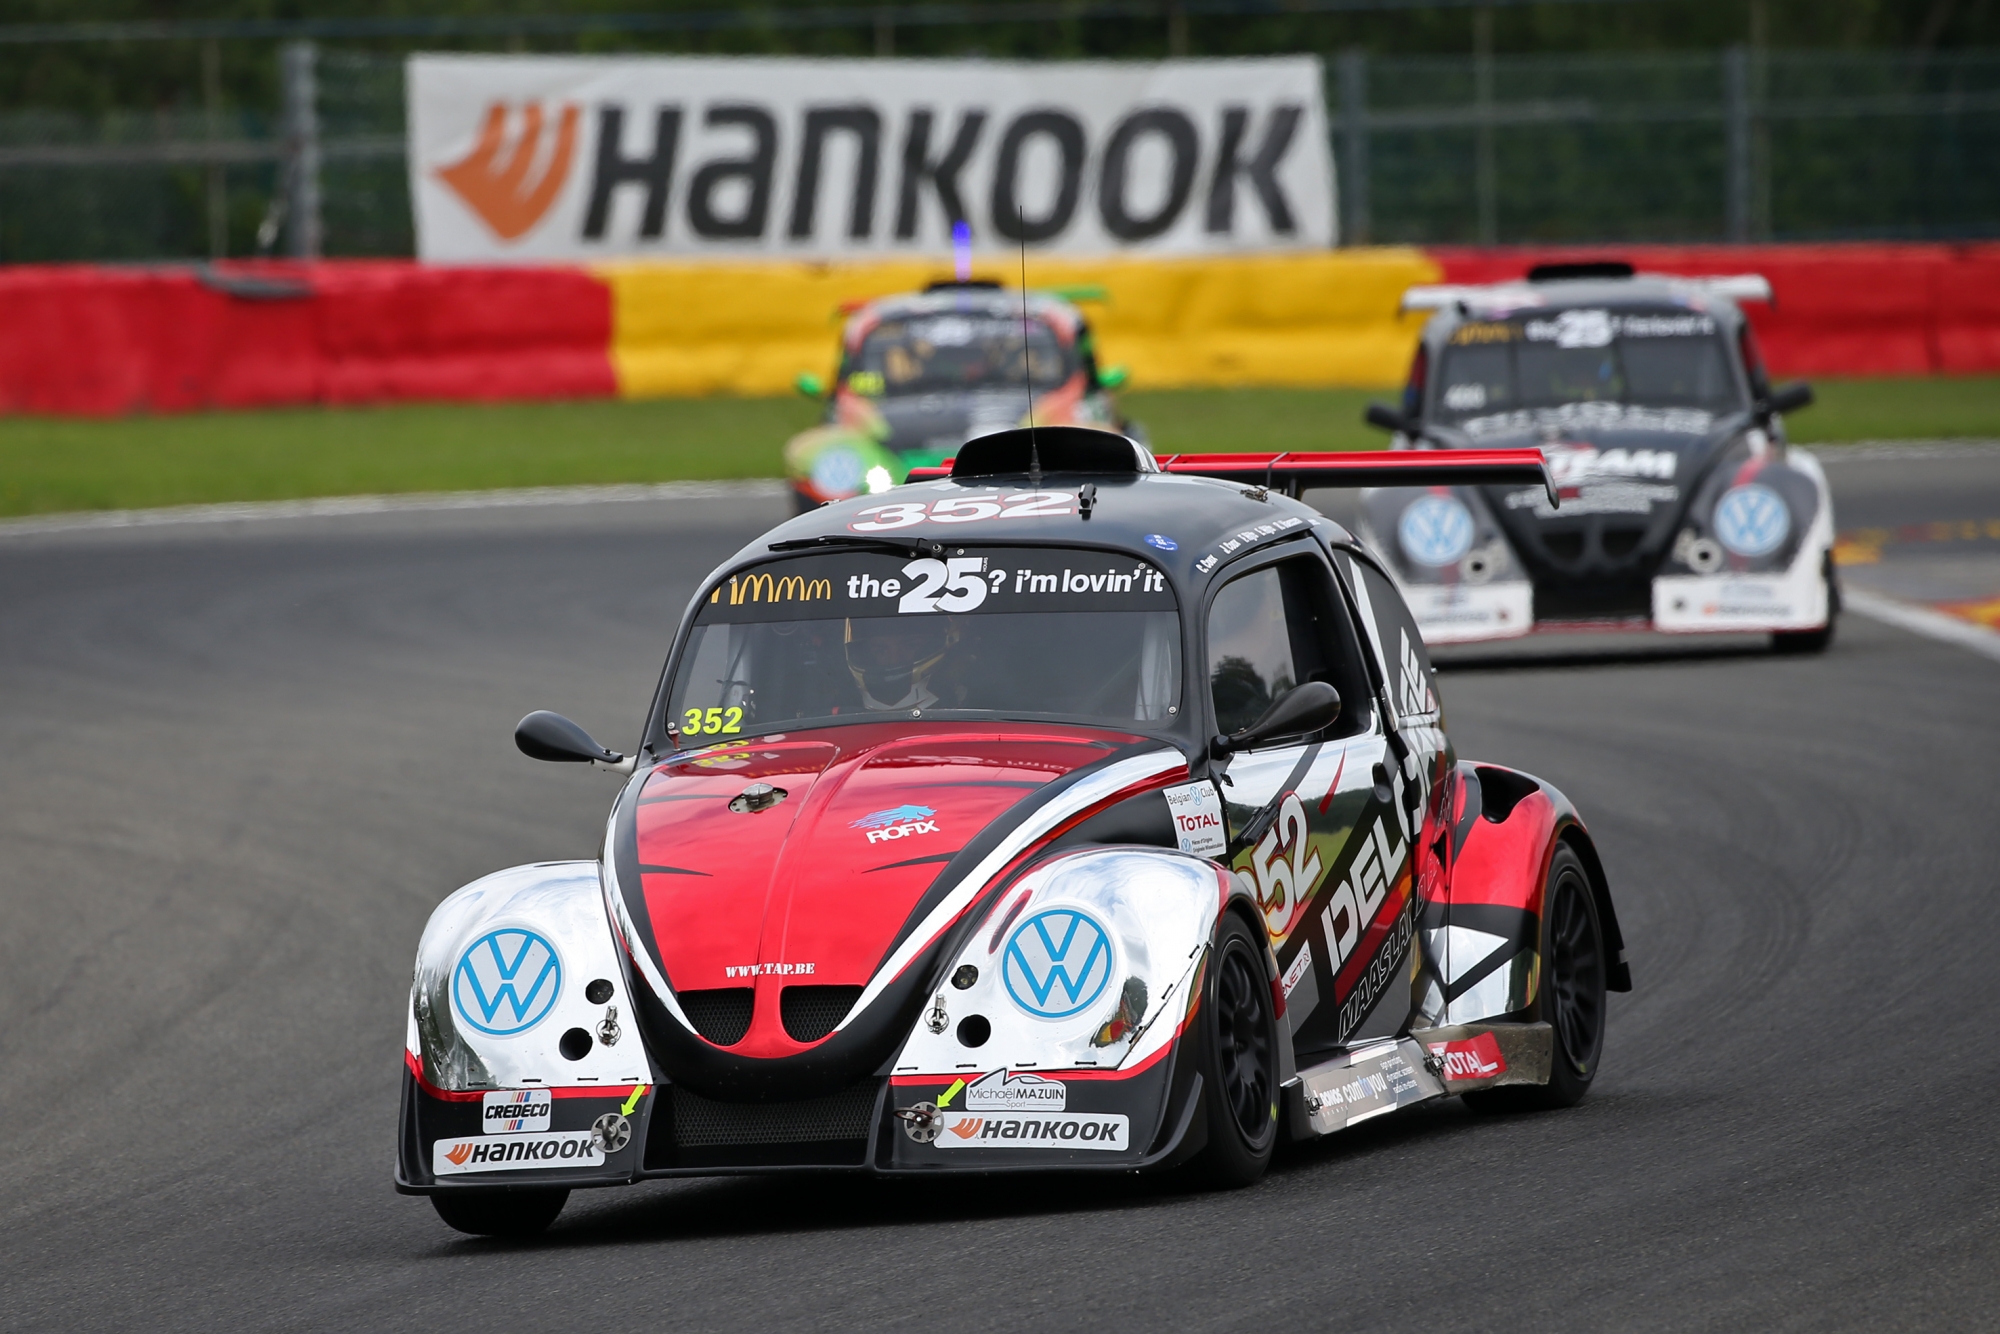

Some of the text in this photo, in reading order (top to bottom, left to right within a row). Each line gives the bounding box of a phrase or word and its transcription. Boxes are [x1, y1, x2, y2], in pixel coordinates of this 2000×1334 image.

[850, 491, 1076, 531] 352
[847, 570, 900, 598] the
[1014, 570, 1058, 593] i'm
[1062, 568, 1139, 593] lovin'
[1143, 568, 1164, 593] it
[682, 706, 743, 735] 352
[1168, 793, 1192, 805] Belgian
[1201, 787, 1215, 798] Club
[866, 820, 940, 844] ROFIX
[1177, 813, 1220, 832] TOTAL
[725, 963, 815, 978] WWW.TAP.BE
[485, 1103, 549, 1119] CREDECO
[1005, 1100, 1026, 1108] Sport
